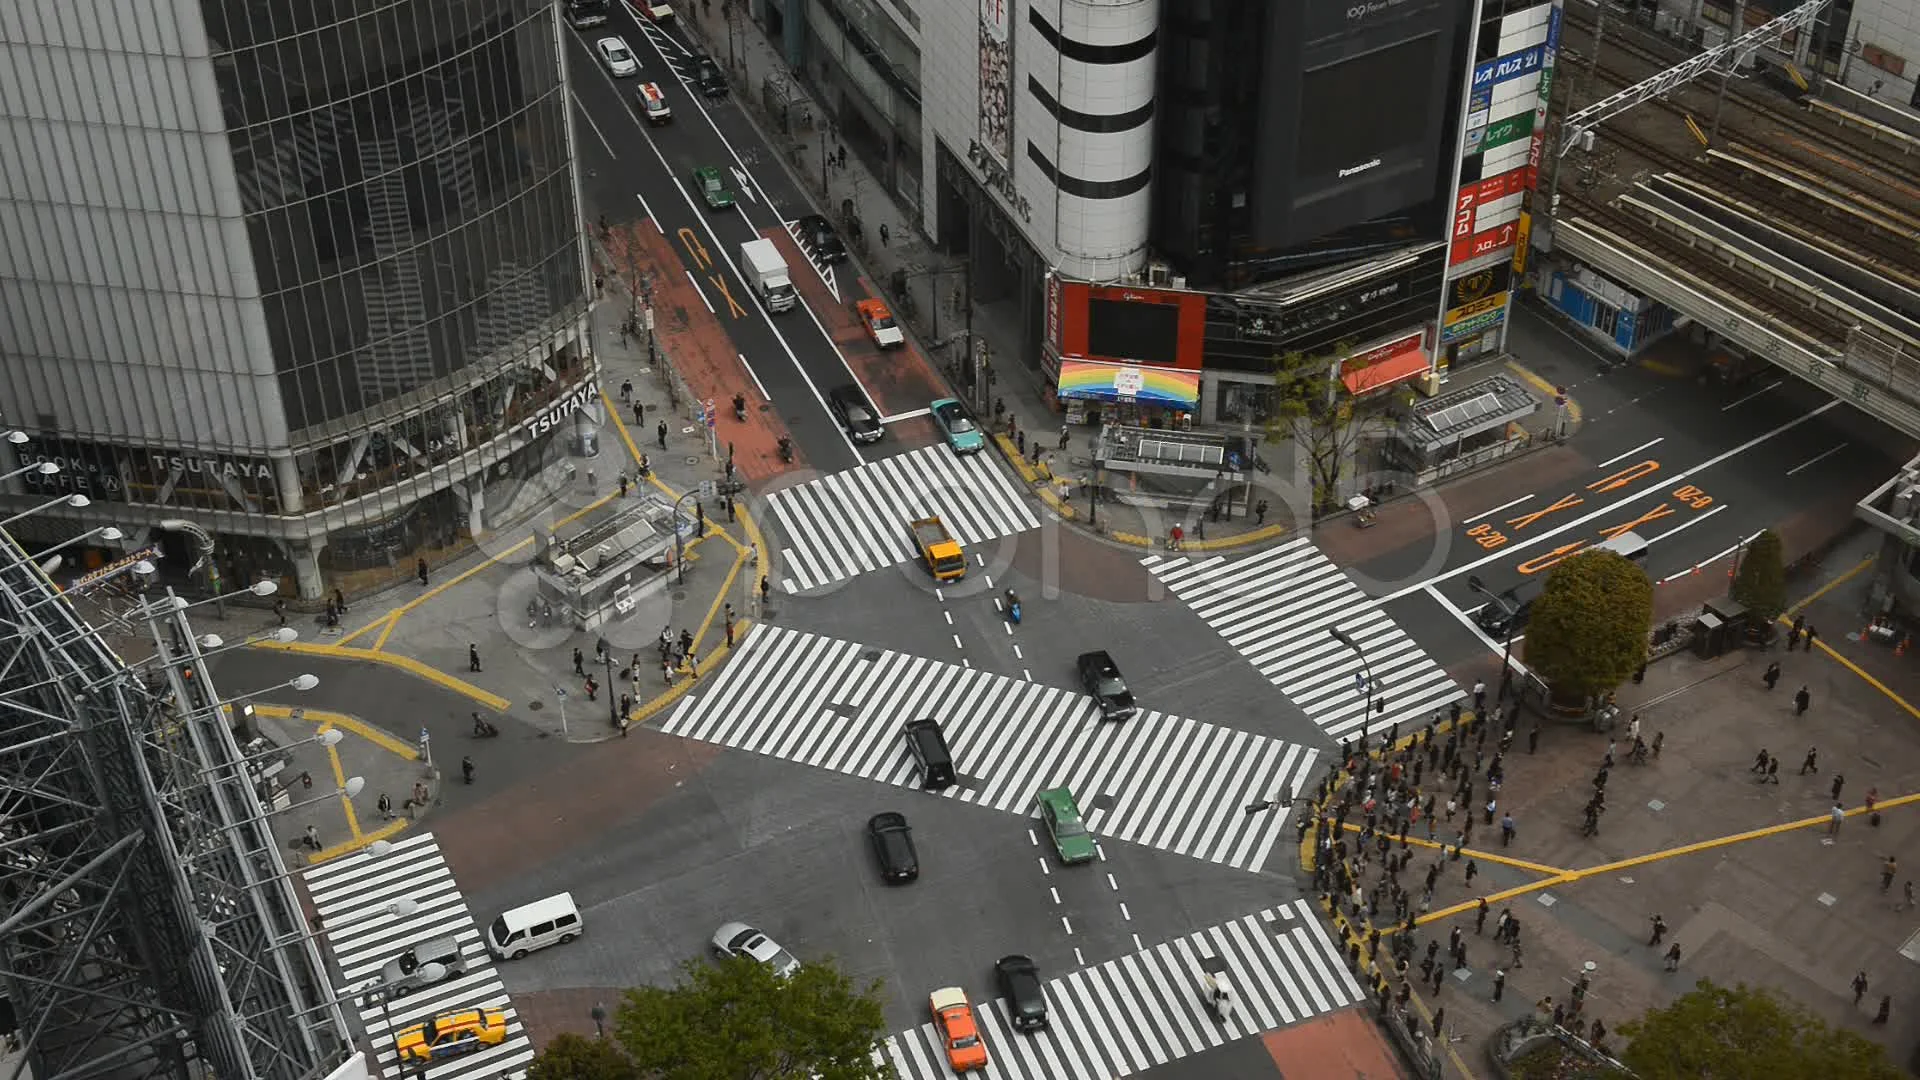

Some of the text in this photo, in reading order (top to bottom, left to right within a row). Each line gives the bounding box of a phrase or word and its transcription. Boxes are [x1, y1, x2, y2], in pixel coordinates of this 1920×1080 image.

[1475, 51, 1538, 84] レオパレス21
[1485, 124, 1513, 141] レイク
[1530, 138, 1542, 167] アコム
[1339, 159, 1381, 178] Panasonic
[1456, 195, 1474, 236] アコム
[1456, 298, 1496, 319] プロミス
[527, 381, 598, 439] TSUTAYA
[19, 453, 84, 473] BOOK
[153, 455, 272, 480] TSUTAYA
[25, 472, 89, 489] CAFE
